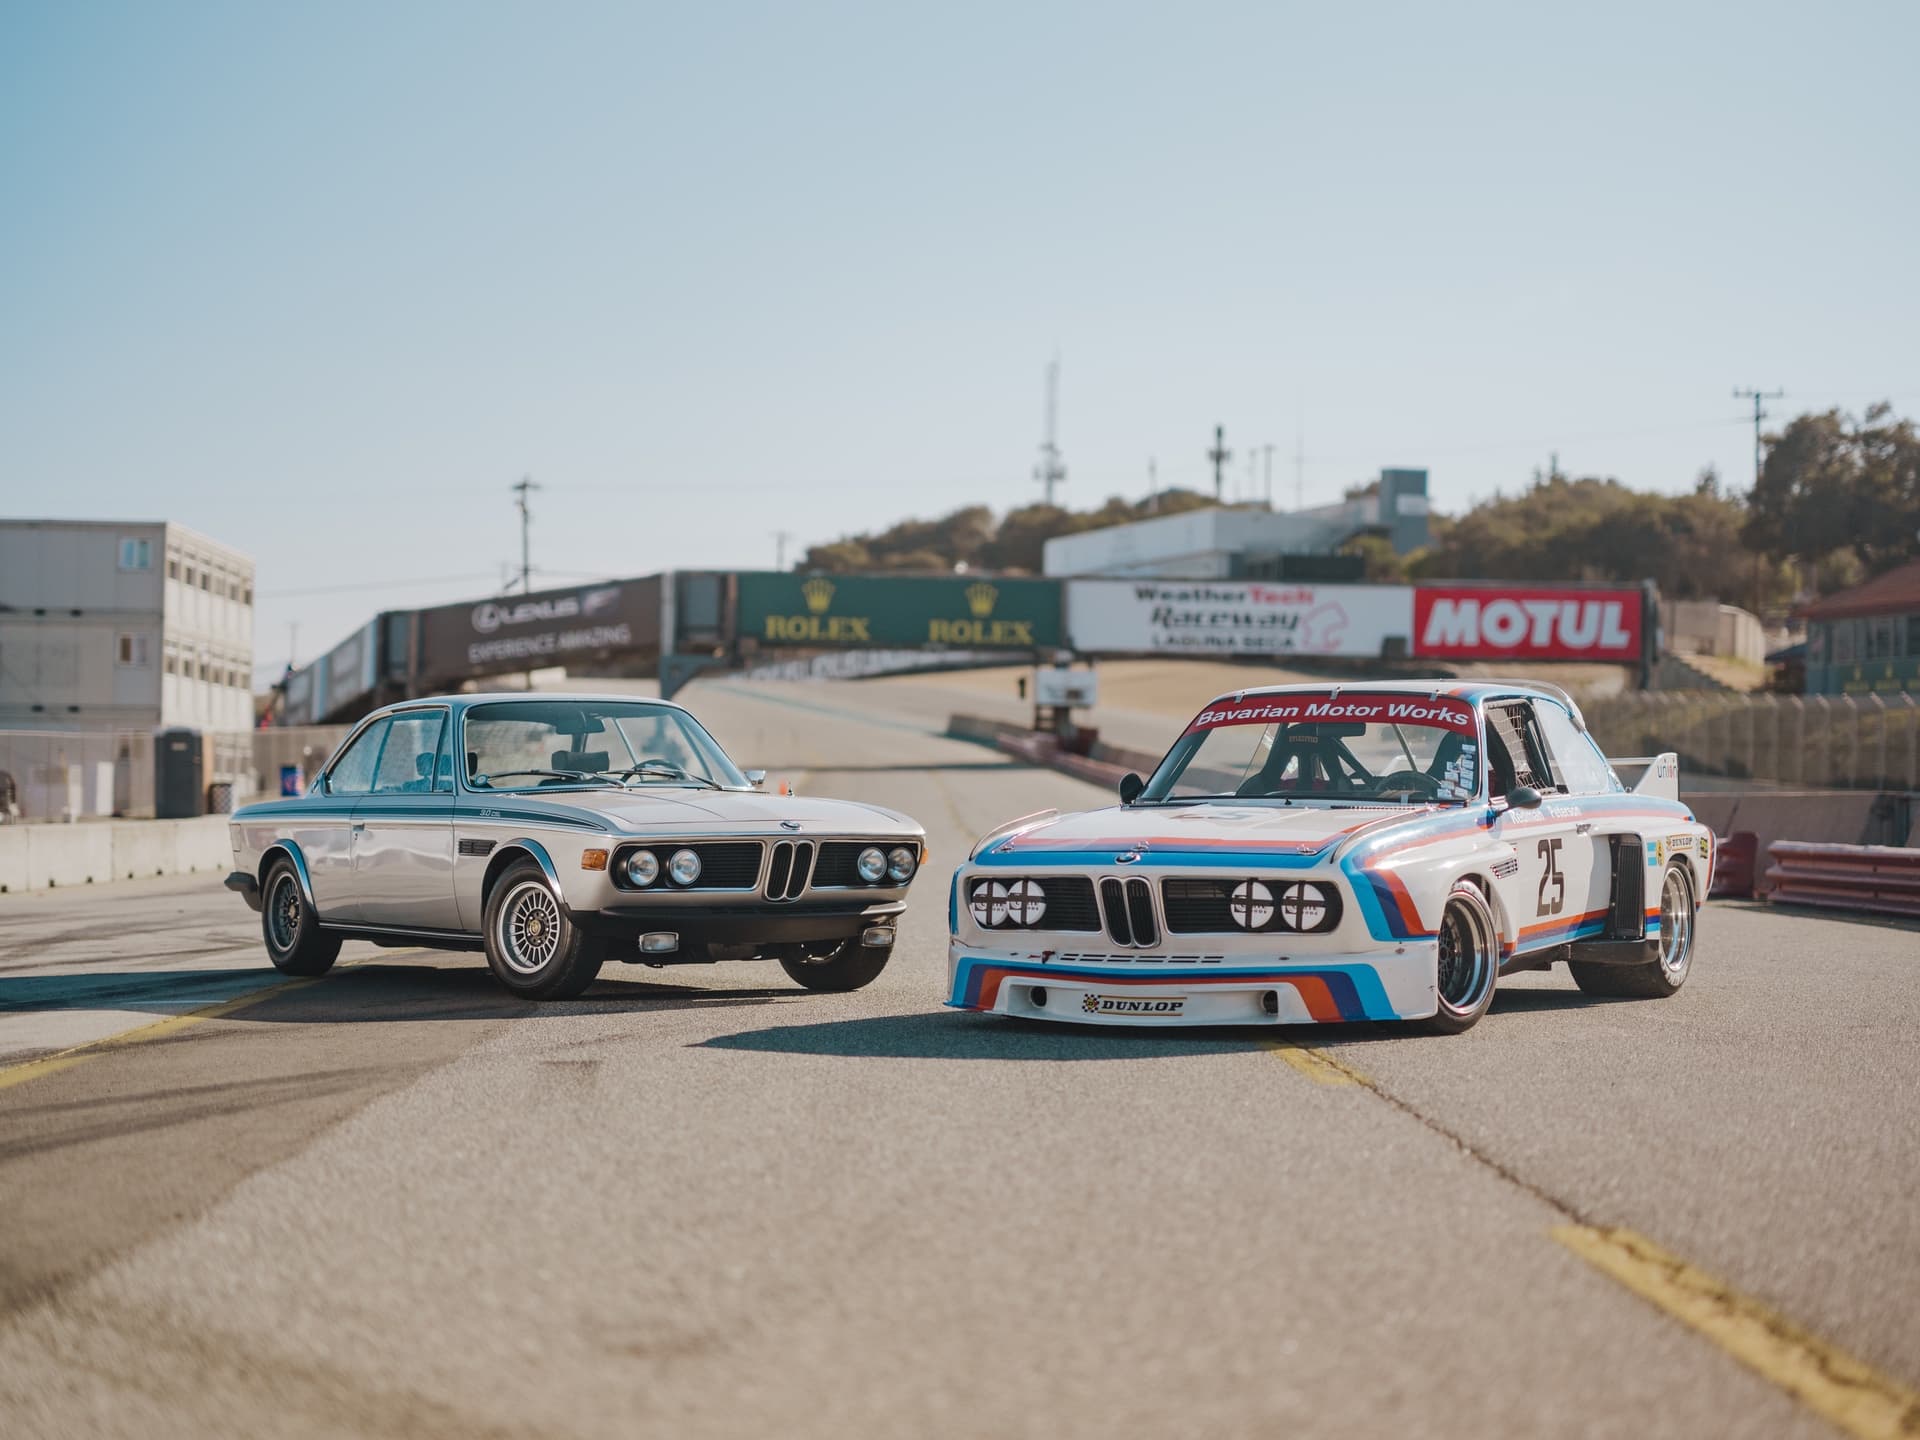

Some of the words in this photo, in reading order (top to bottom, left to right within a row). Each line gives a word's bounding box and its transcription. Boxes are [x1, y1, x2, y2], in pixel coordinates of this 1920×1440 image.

[1135, 586, 1315, 605] WeatherTech
[765, 615, 871, 641] ROLEX
[1151, 606, 1300, 630] Raceway
[1422, 598, 1631, 649] MOTUL
[928, 619, 1033, 645] ROLEX
[1153, 635, 1239, 648] LAGUNA
[1242, 635, 1296, 648] SECA
[468, 632, 556, 664] EXPERIENCE
[1195, 703, 1300, 727] Bavarian
[1304, 702, 1384, 718] Motor
[1387, 703, 1470, 726] Works
[1536, 838, 1564, 917] 25
[1101, 1000, 1184, 1012] DUNLOP
